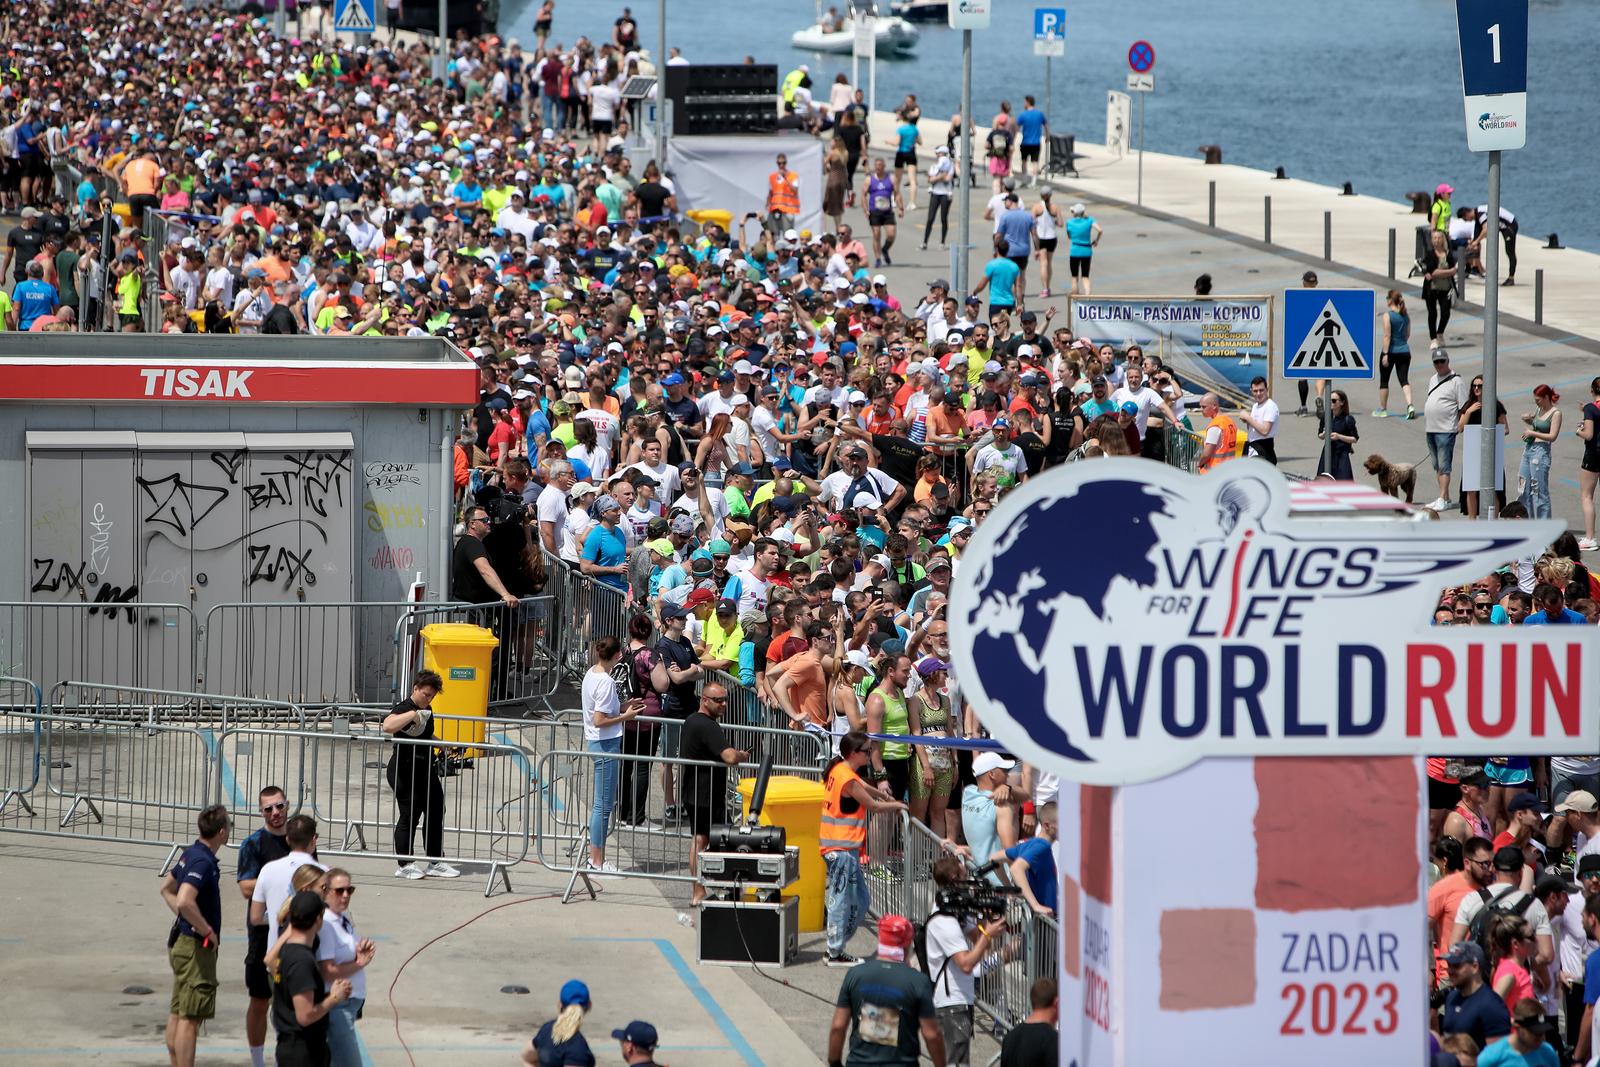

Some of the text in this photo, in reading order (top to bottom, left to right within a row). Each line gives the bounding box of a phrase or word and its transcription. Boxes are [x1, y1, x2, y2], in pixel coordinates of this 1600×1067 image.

[1487, 23, 1501, 64] 1
[1484, 121, 1504, 129] WORLD
[1079, 305, 1133, 321] UGLJAN
[1143, 304, 1201, 321] PAŠMAN
[1213, 305, 1263, 321] KOPNO
[140, 368, 254, 398] TISAK
[1146, 595, 1315, 638] FOR LIFE
[1073, 642, 1582, 739] WORLD RUN
[1281, 932, 1400, 973] ZADAR
[1280, 982, 1399, 1036] 2023
